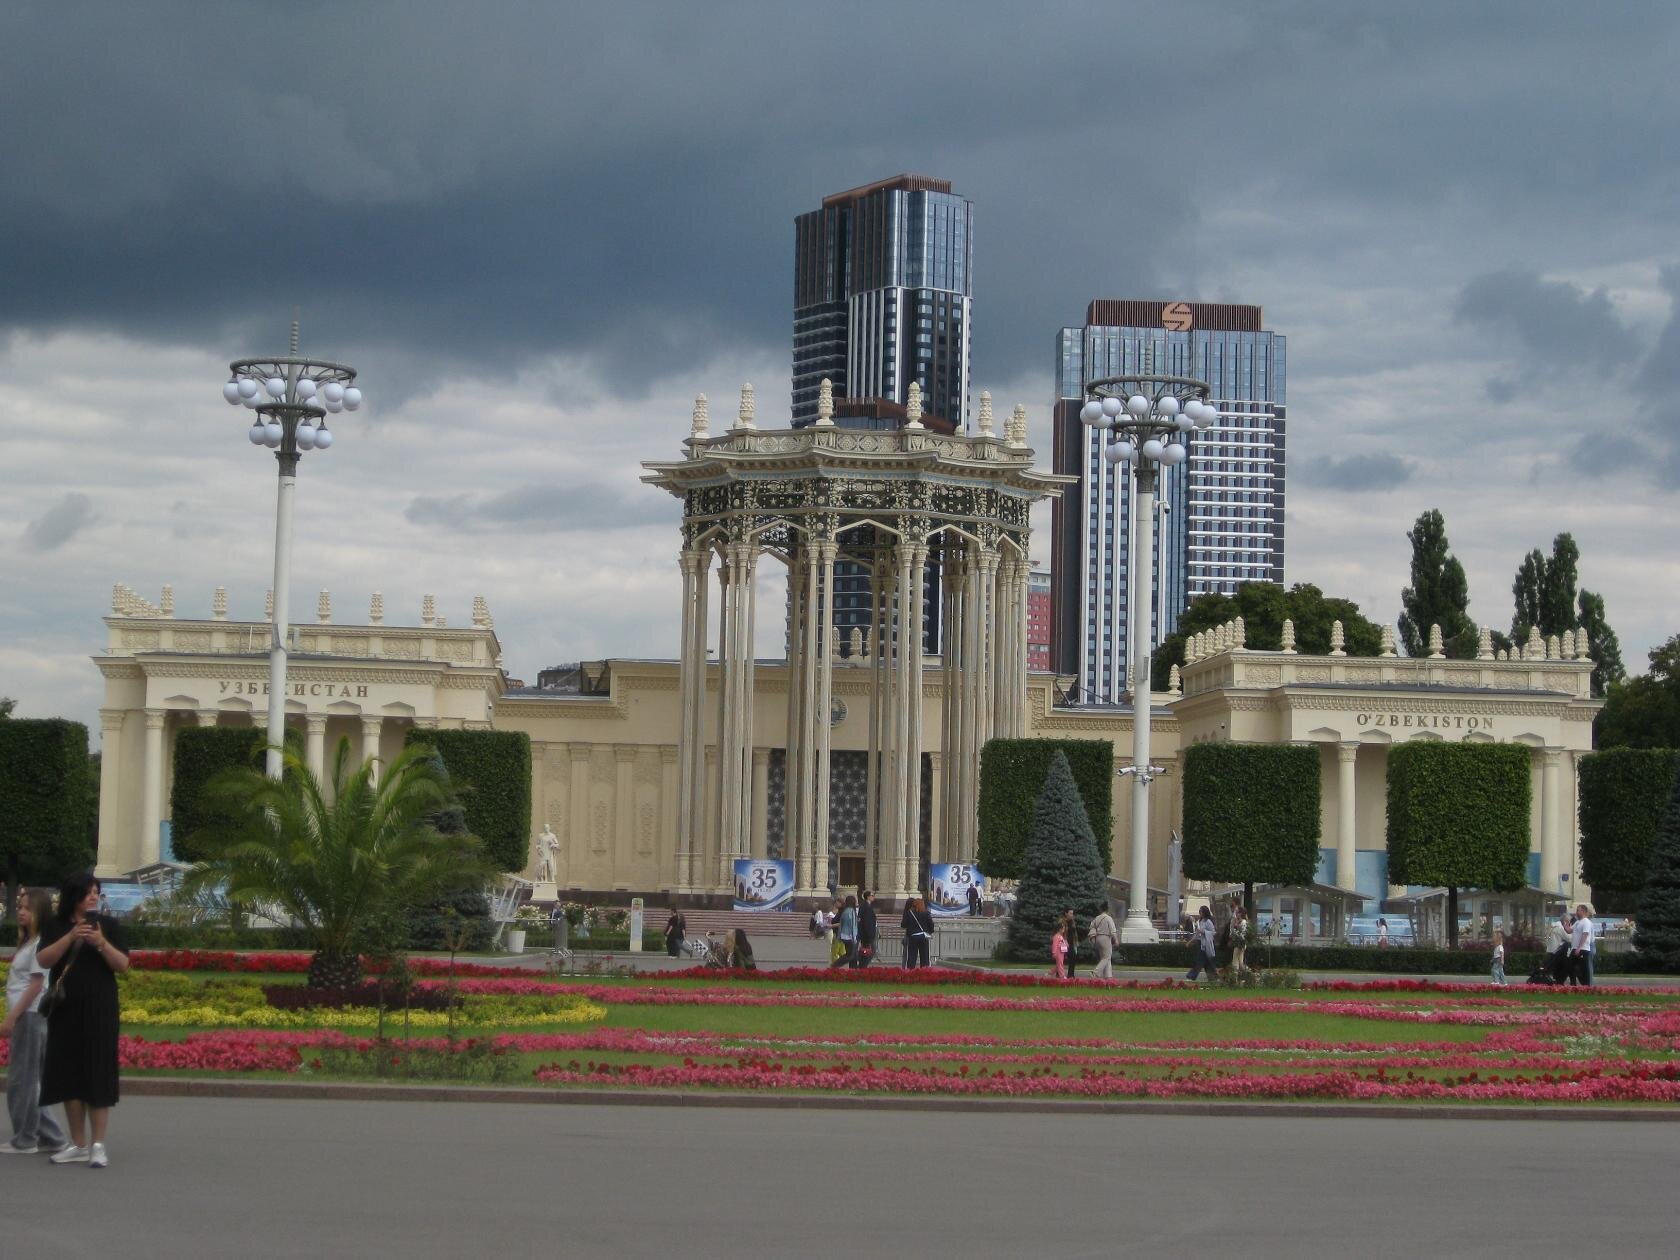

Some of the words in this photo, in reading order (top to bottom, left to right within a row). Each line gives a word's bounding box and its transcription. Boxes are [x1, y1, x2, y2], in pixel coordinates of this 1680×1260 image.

[219, 681, 369, 698] УЗБЕИСТАН
[752, 868, 777, 888] 35
[951, 865, 971, 884] 35
